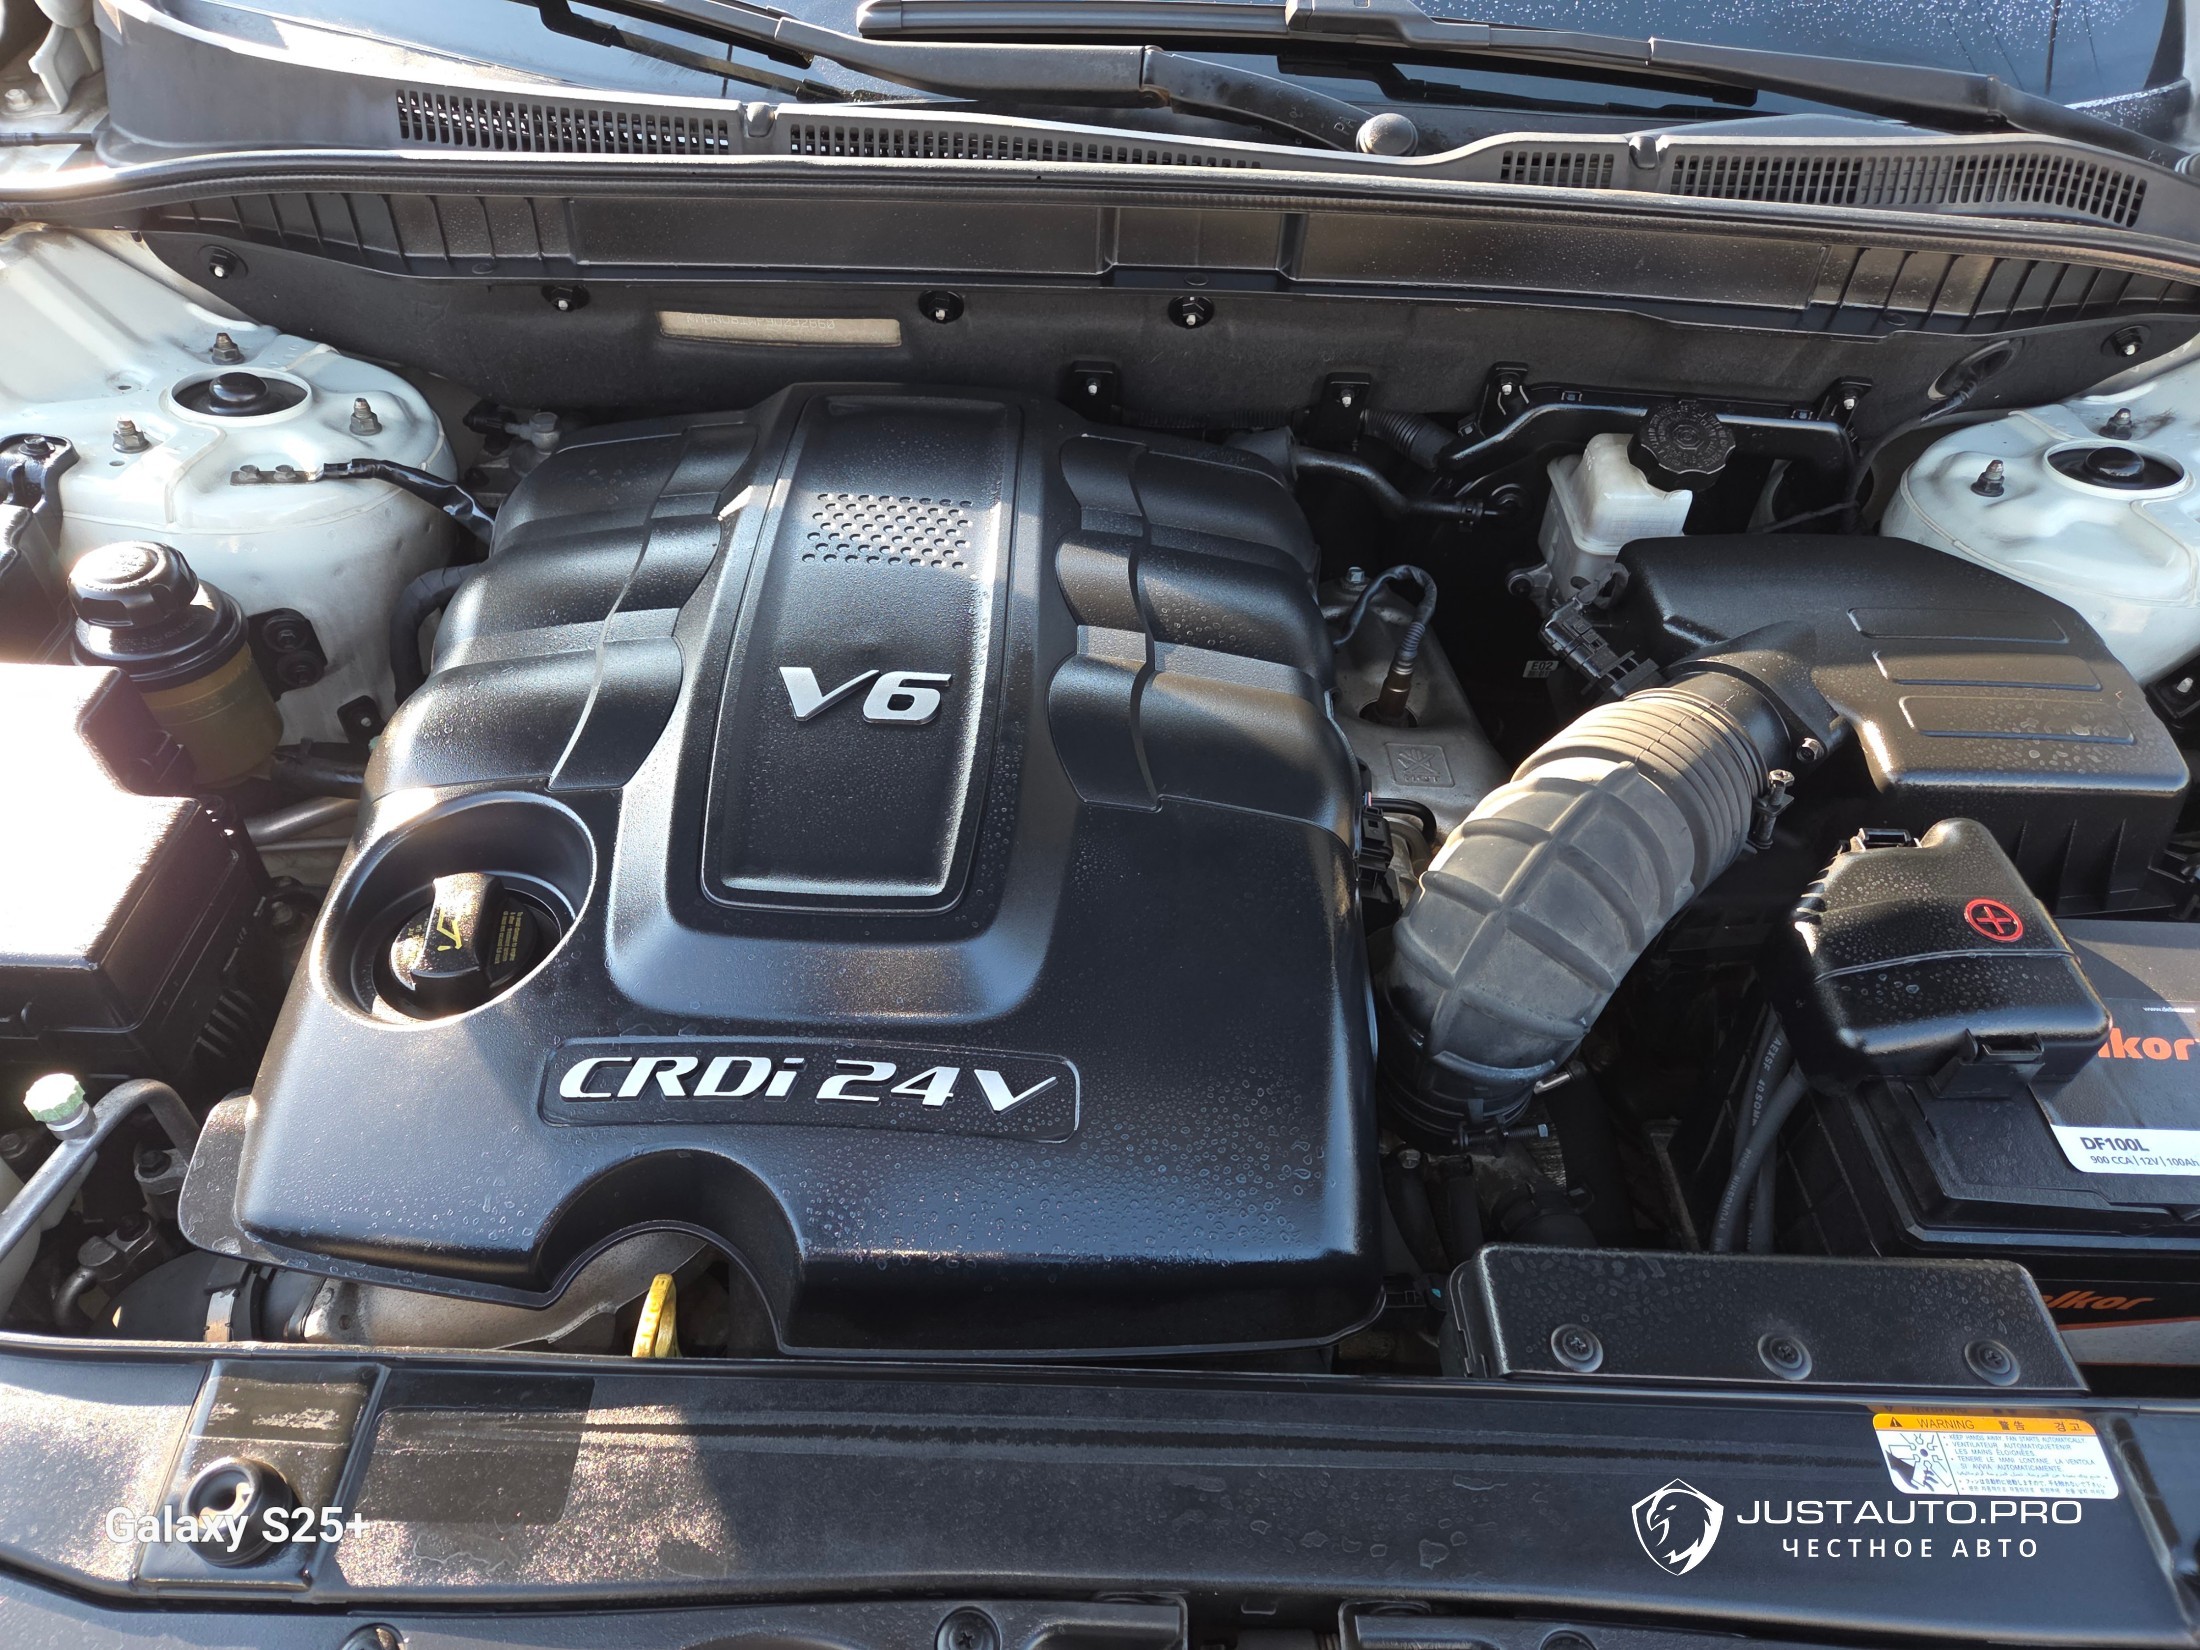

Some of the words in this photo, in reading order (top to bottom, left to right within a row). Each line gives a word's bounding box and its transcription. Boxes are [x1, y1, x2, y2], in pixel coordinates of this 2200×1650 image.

[778, 666, 952, 725] V6
[559, 1056, 805, 1101] CRDi
[816, 1059, 1058, 1112] 24V
[2080, 1136, 2150, 1152] DF100L
[2090, 1155, 2110, 1164] 900
[1916, 1418, 1975, 1430] WARNING
[2054, 1422, 2082, 1432] 경고
[1952, 1441, 1998, 1449] VENTILATEUR
